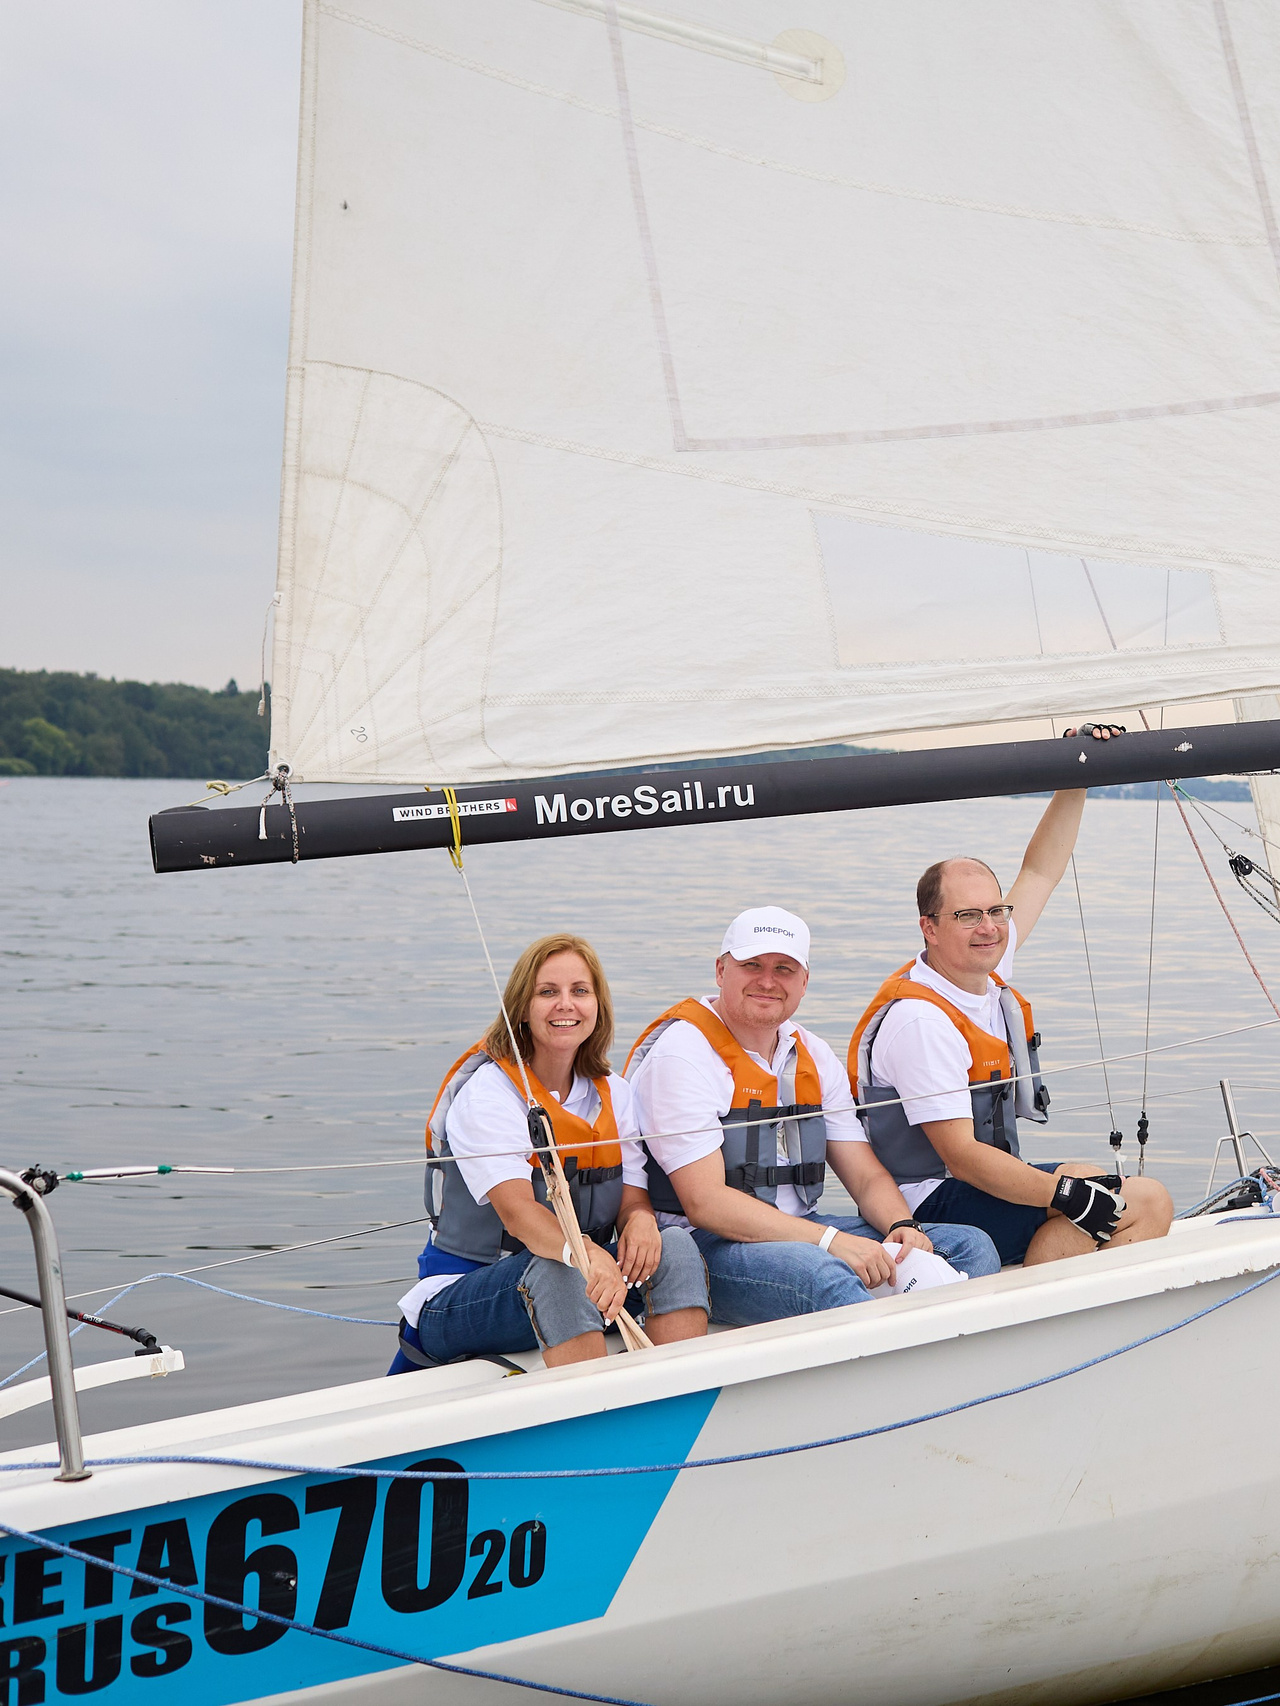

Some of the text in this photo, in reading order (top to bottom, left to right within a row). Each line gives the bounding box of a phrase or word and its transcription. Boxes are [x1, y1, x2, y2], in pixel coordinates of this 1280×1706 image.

[350, 726, 368, 743] 20
[399, 802, 500, 818] WIND BROTHERS
[534, 781, 755, 825] MoreSail.ru
[753, 926, 794, 938] ВИФЕРОН
[203, 1457, 547, 1656] 670 20
[0, 1517, 199, 1628] ETA
